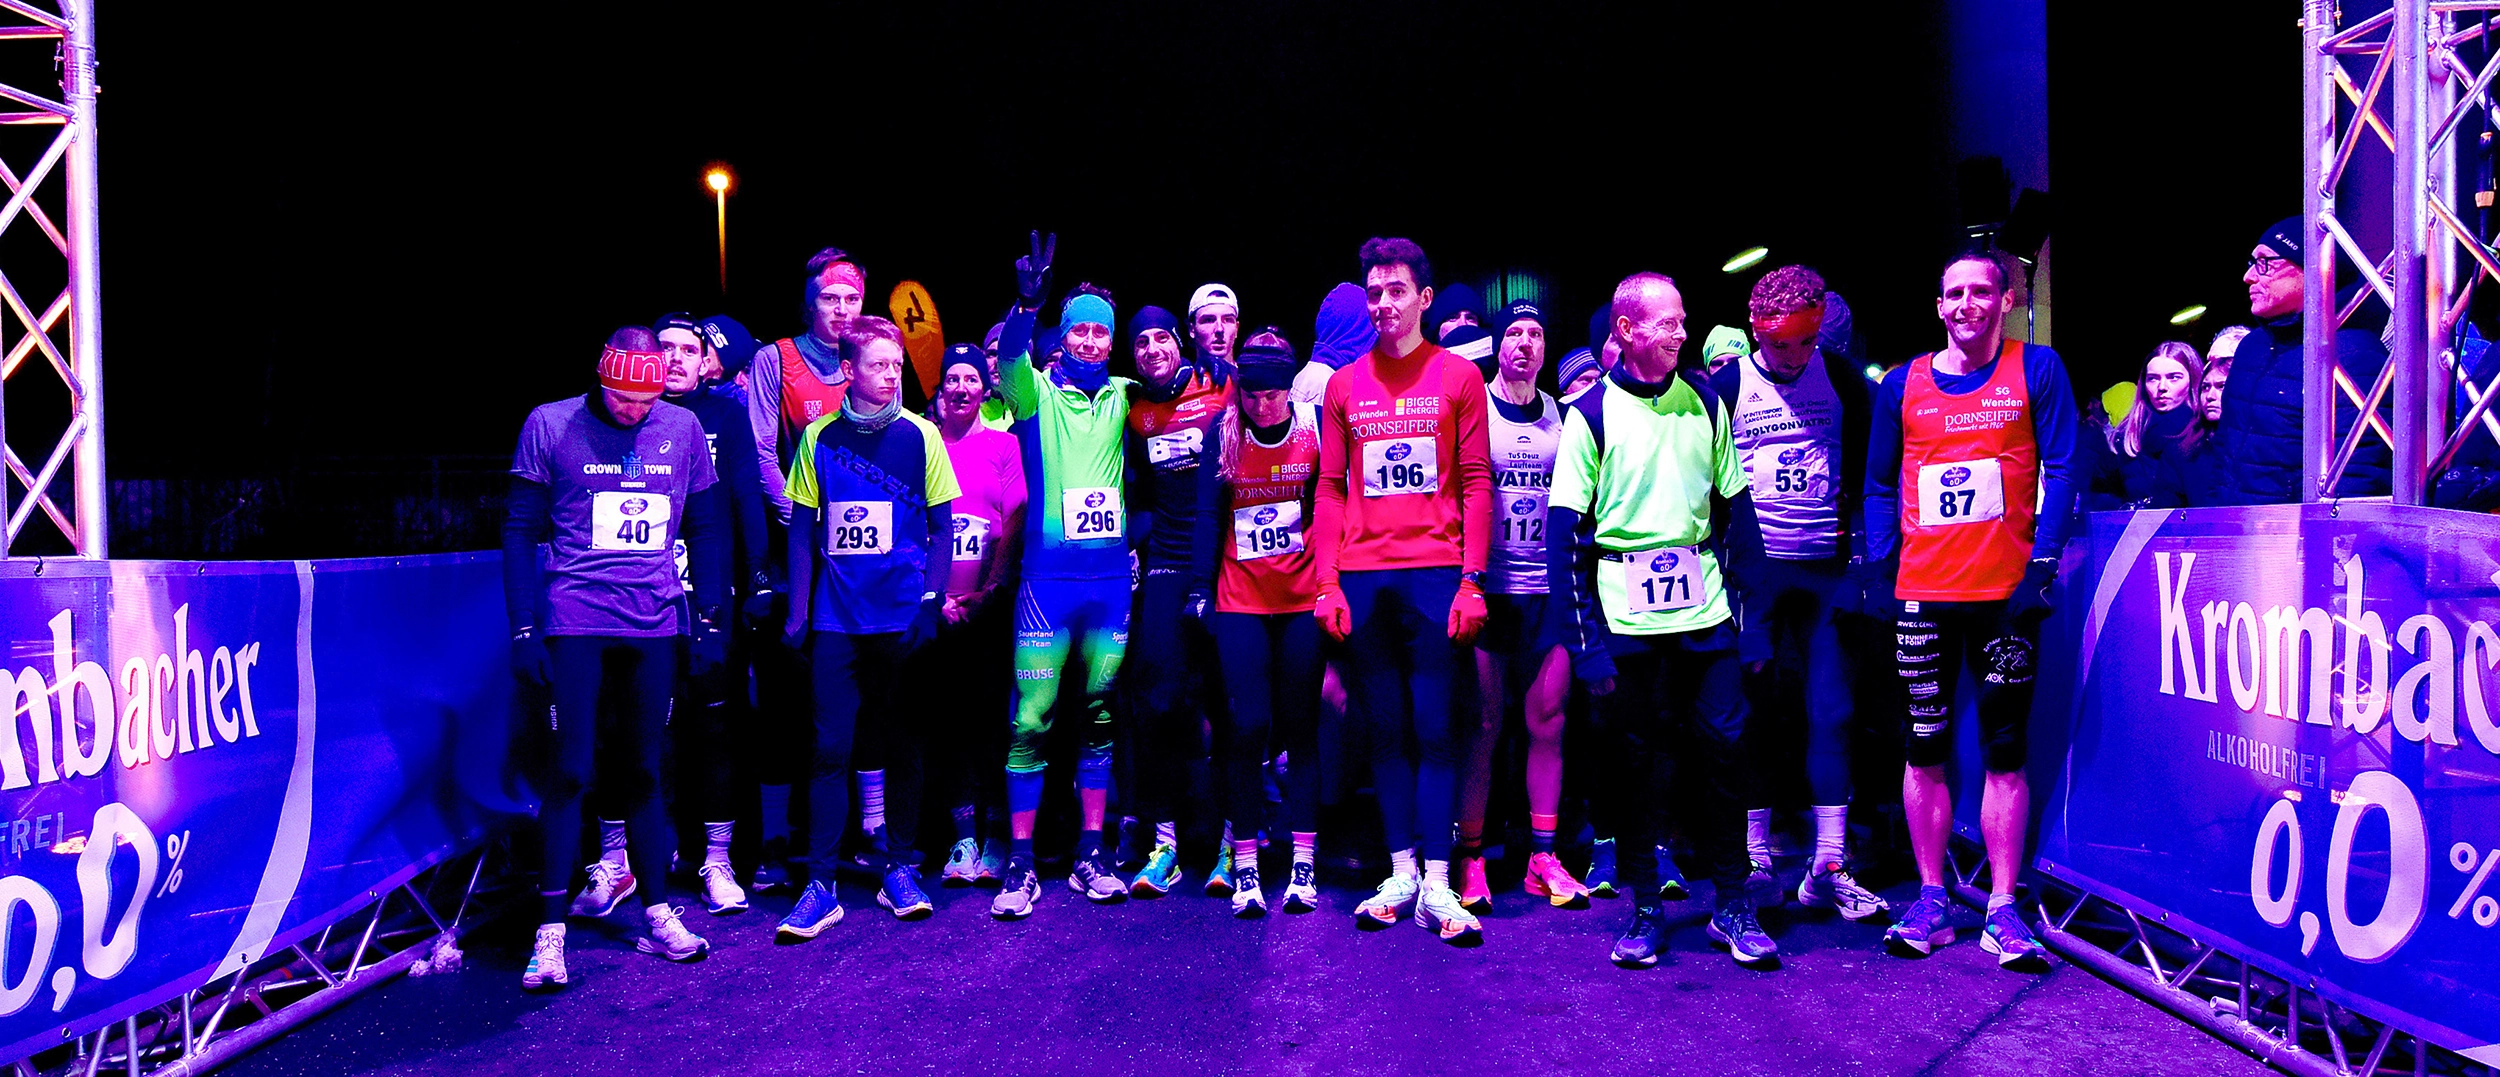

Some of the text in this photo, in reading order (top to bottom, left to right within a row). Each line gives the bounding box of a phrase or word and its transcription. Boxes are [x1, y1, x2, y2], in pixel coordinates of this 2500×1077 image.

[1406, 397, 1440, 407] BIGGE
[1995, 386, 2010, 395] SG
[1406, 407, 1440, 415] ENERGIE
[1981, 397, 2023, 408] Wenden
[1349, 410, 1389, 422] SG Wenden
[583, 464, 622, 475] CROWN
[643, 464, 672, 475] TOWN
[1281, 463, 1311, 473] BIGGE
[1376, 463, 1424, 489] 196
[1775, 469, 1808, 492] 53
[1940, 489, 1976, 518] 87
[616, 520, 650, 544] 40
[1076, 510, 1115, 533] 296
[1502, 518, 1543, 541] 112
[836, 526, 878, 549] 293
[1247, 526, 1291, 552] 195
[1641, 573, 1690, 605] 171
[1018, 630, 1054, 638] Sauerland
[1019, 640, 1052, 648] Ski Team
[2154, 551, 2500, 755] Krombac
[1017, 668, 1054, 680] BRUSE
[2207, 730, 2326, 790] ALKOHOLFREI
